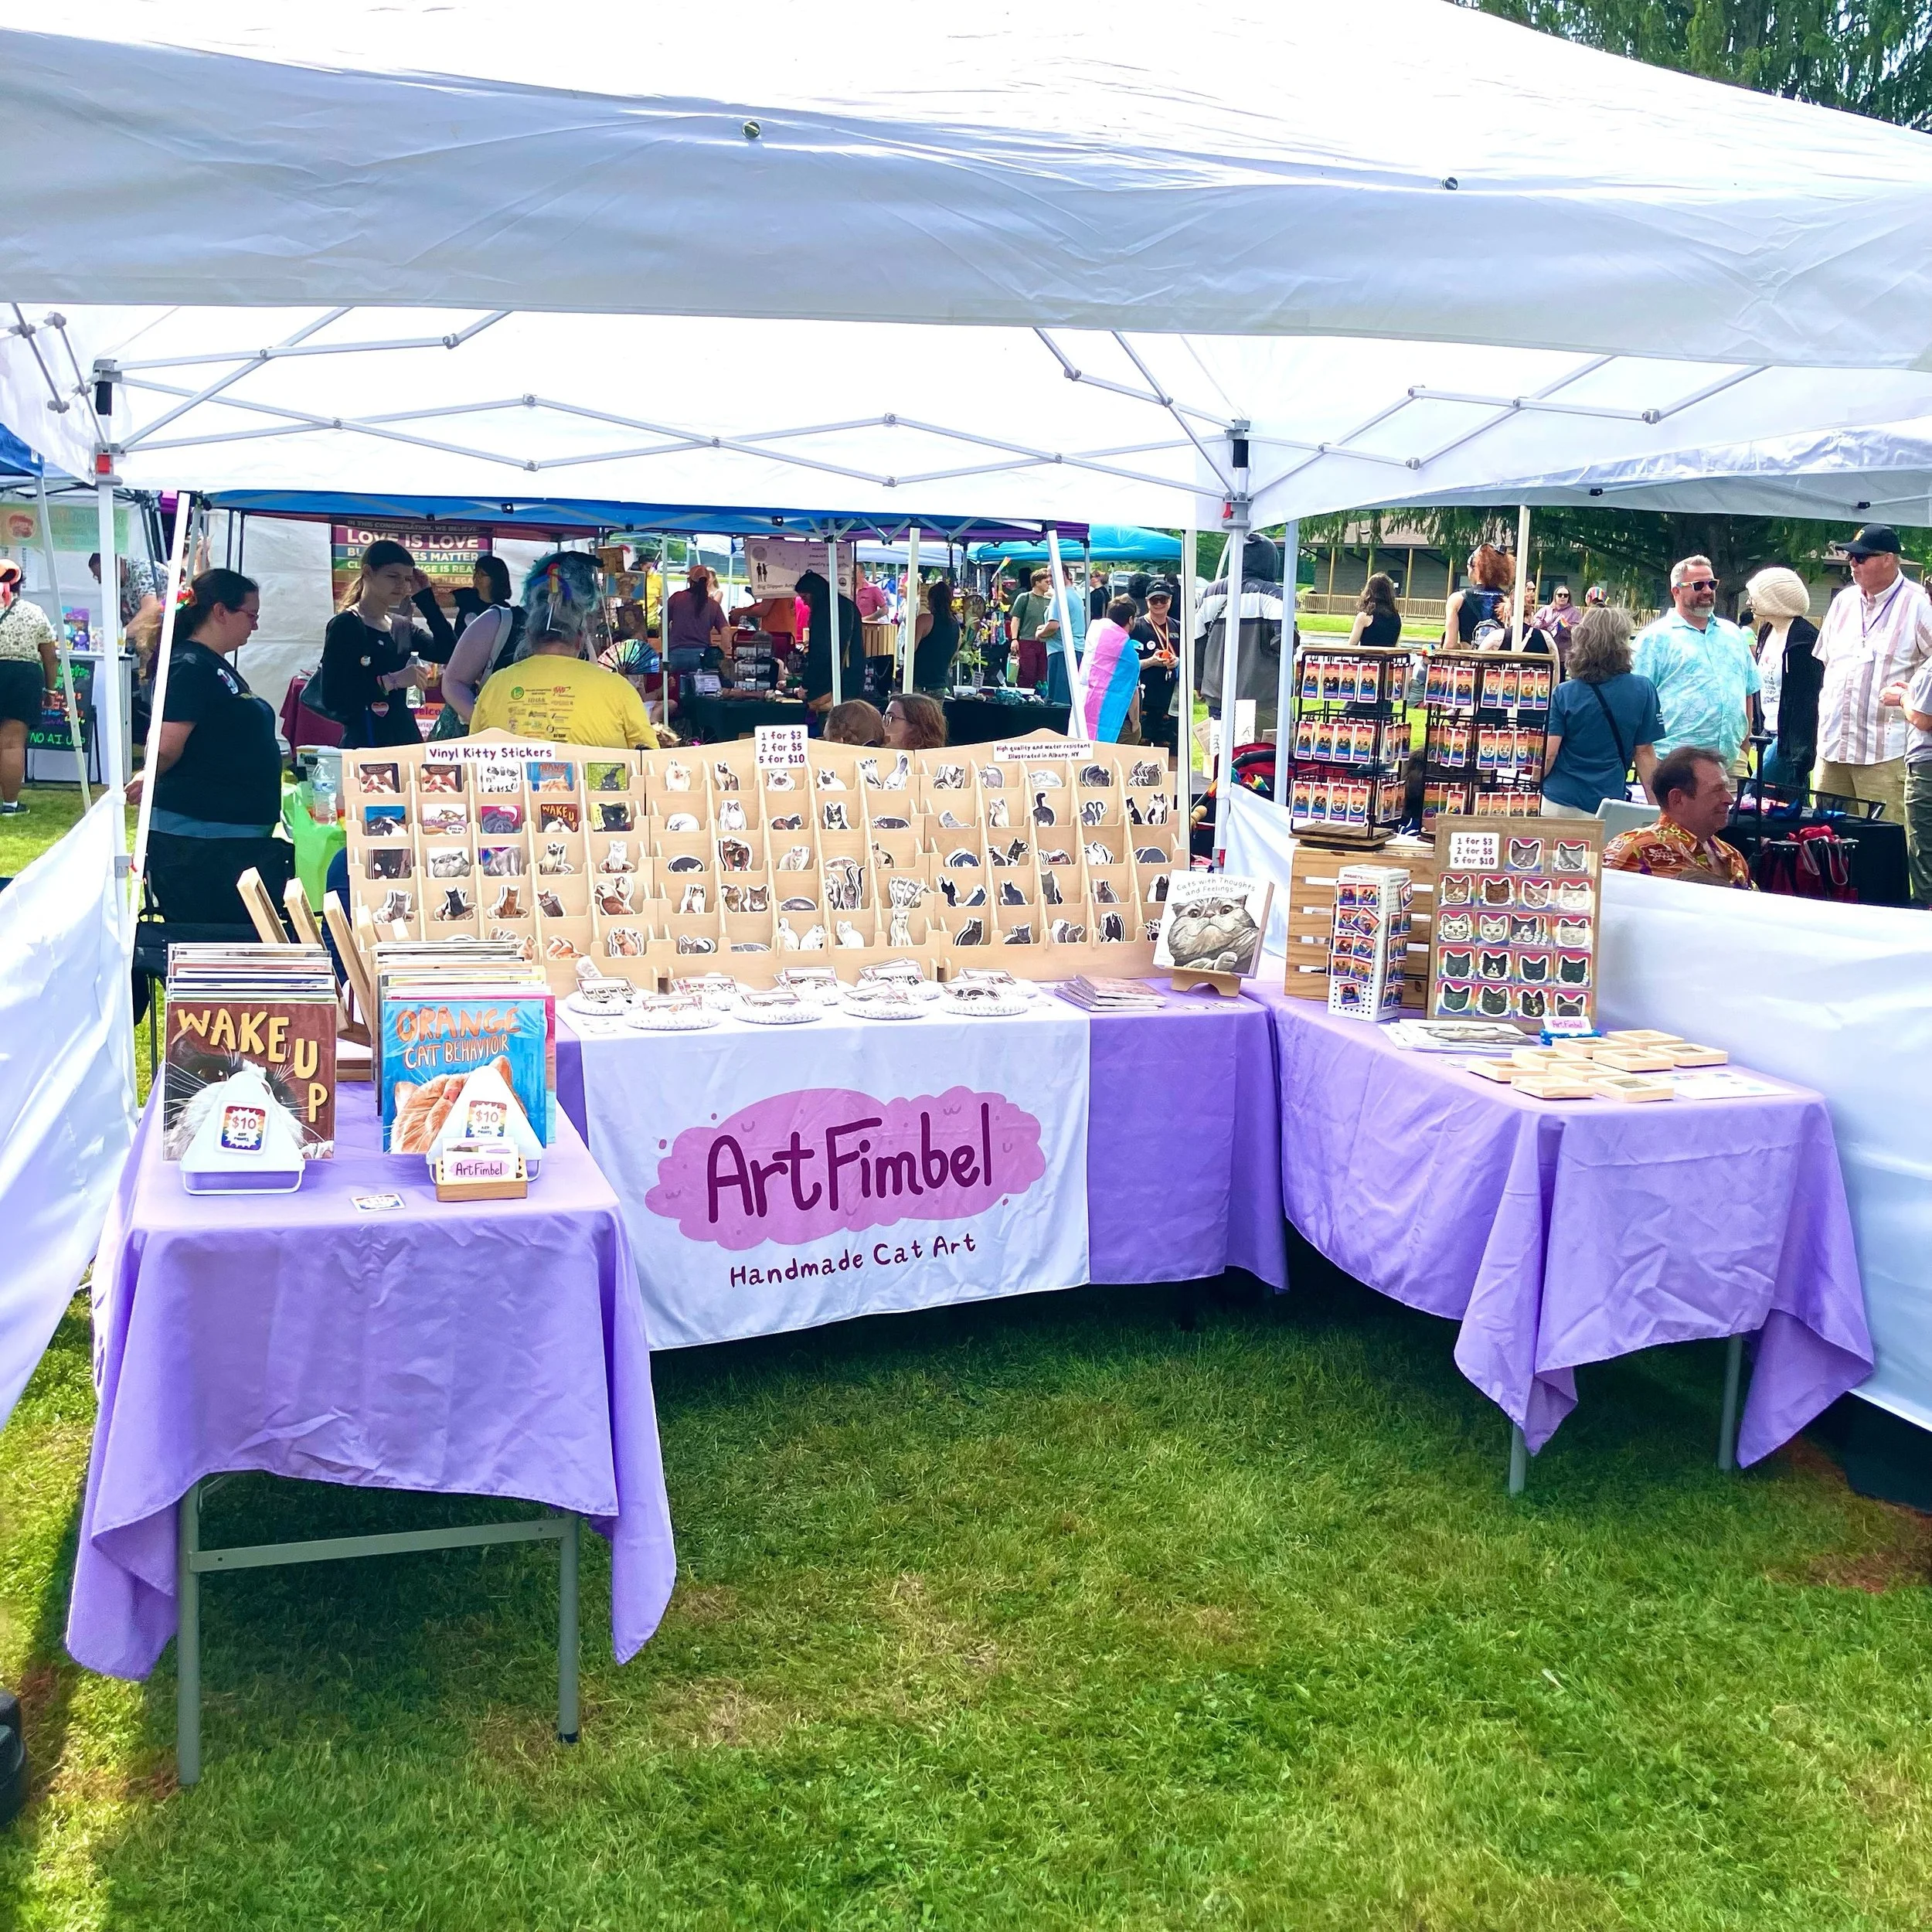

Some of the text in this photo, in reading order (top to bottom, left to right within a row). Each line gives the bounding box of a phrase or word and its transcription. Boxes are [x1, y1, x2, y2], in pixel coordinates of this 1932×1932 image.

[348, 529, 479, 549] LOVE IS LOVE
[430, 553, 478, 561] MATTER
[440, 564, 450, 573] IS
[452, 565, 475, 573] REA
[30, 732, 44, 743] NO
[47, 733, 62, 744] AI
[770, 731, 787, 740] for
[791, 730, 801, 740] $3
[429, 747, 553, 761] Vinyl Kitty Stickers
[761, 742, 802, 753] 2 for $5
[768, 755, 784, 764] for
[788, 753, 805, 764] $10
[542, 805, 567, 818] WAKE
[1483, 837, 1493, 846] $3
[1457, 846, 1462, 855] 2
[1483, 847, 1493, 855] $5
[1462, 855, 1477, 864] for
[1479, 856, 1495, 866] $10
[1176, 880, 1196, 891] Cats
[1219, 876, 1256, 892] Thoughts
[396, 1006, 522, 1042] ORANGE
[177, 1008, 290, 1063] WAKE
[404, 1034, 510, 1070] CAT BEHAVIOR
[232, 1115, 257, 1130] $10
[475, 1109, 498, 1123] $10
[456, 1162, 502, 1176] ArtFimbel
[707, 1102, 992, 1224] ArtFimbel
[730, 1233, 977, 1287] Handmade Cat Art
